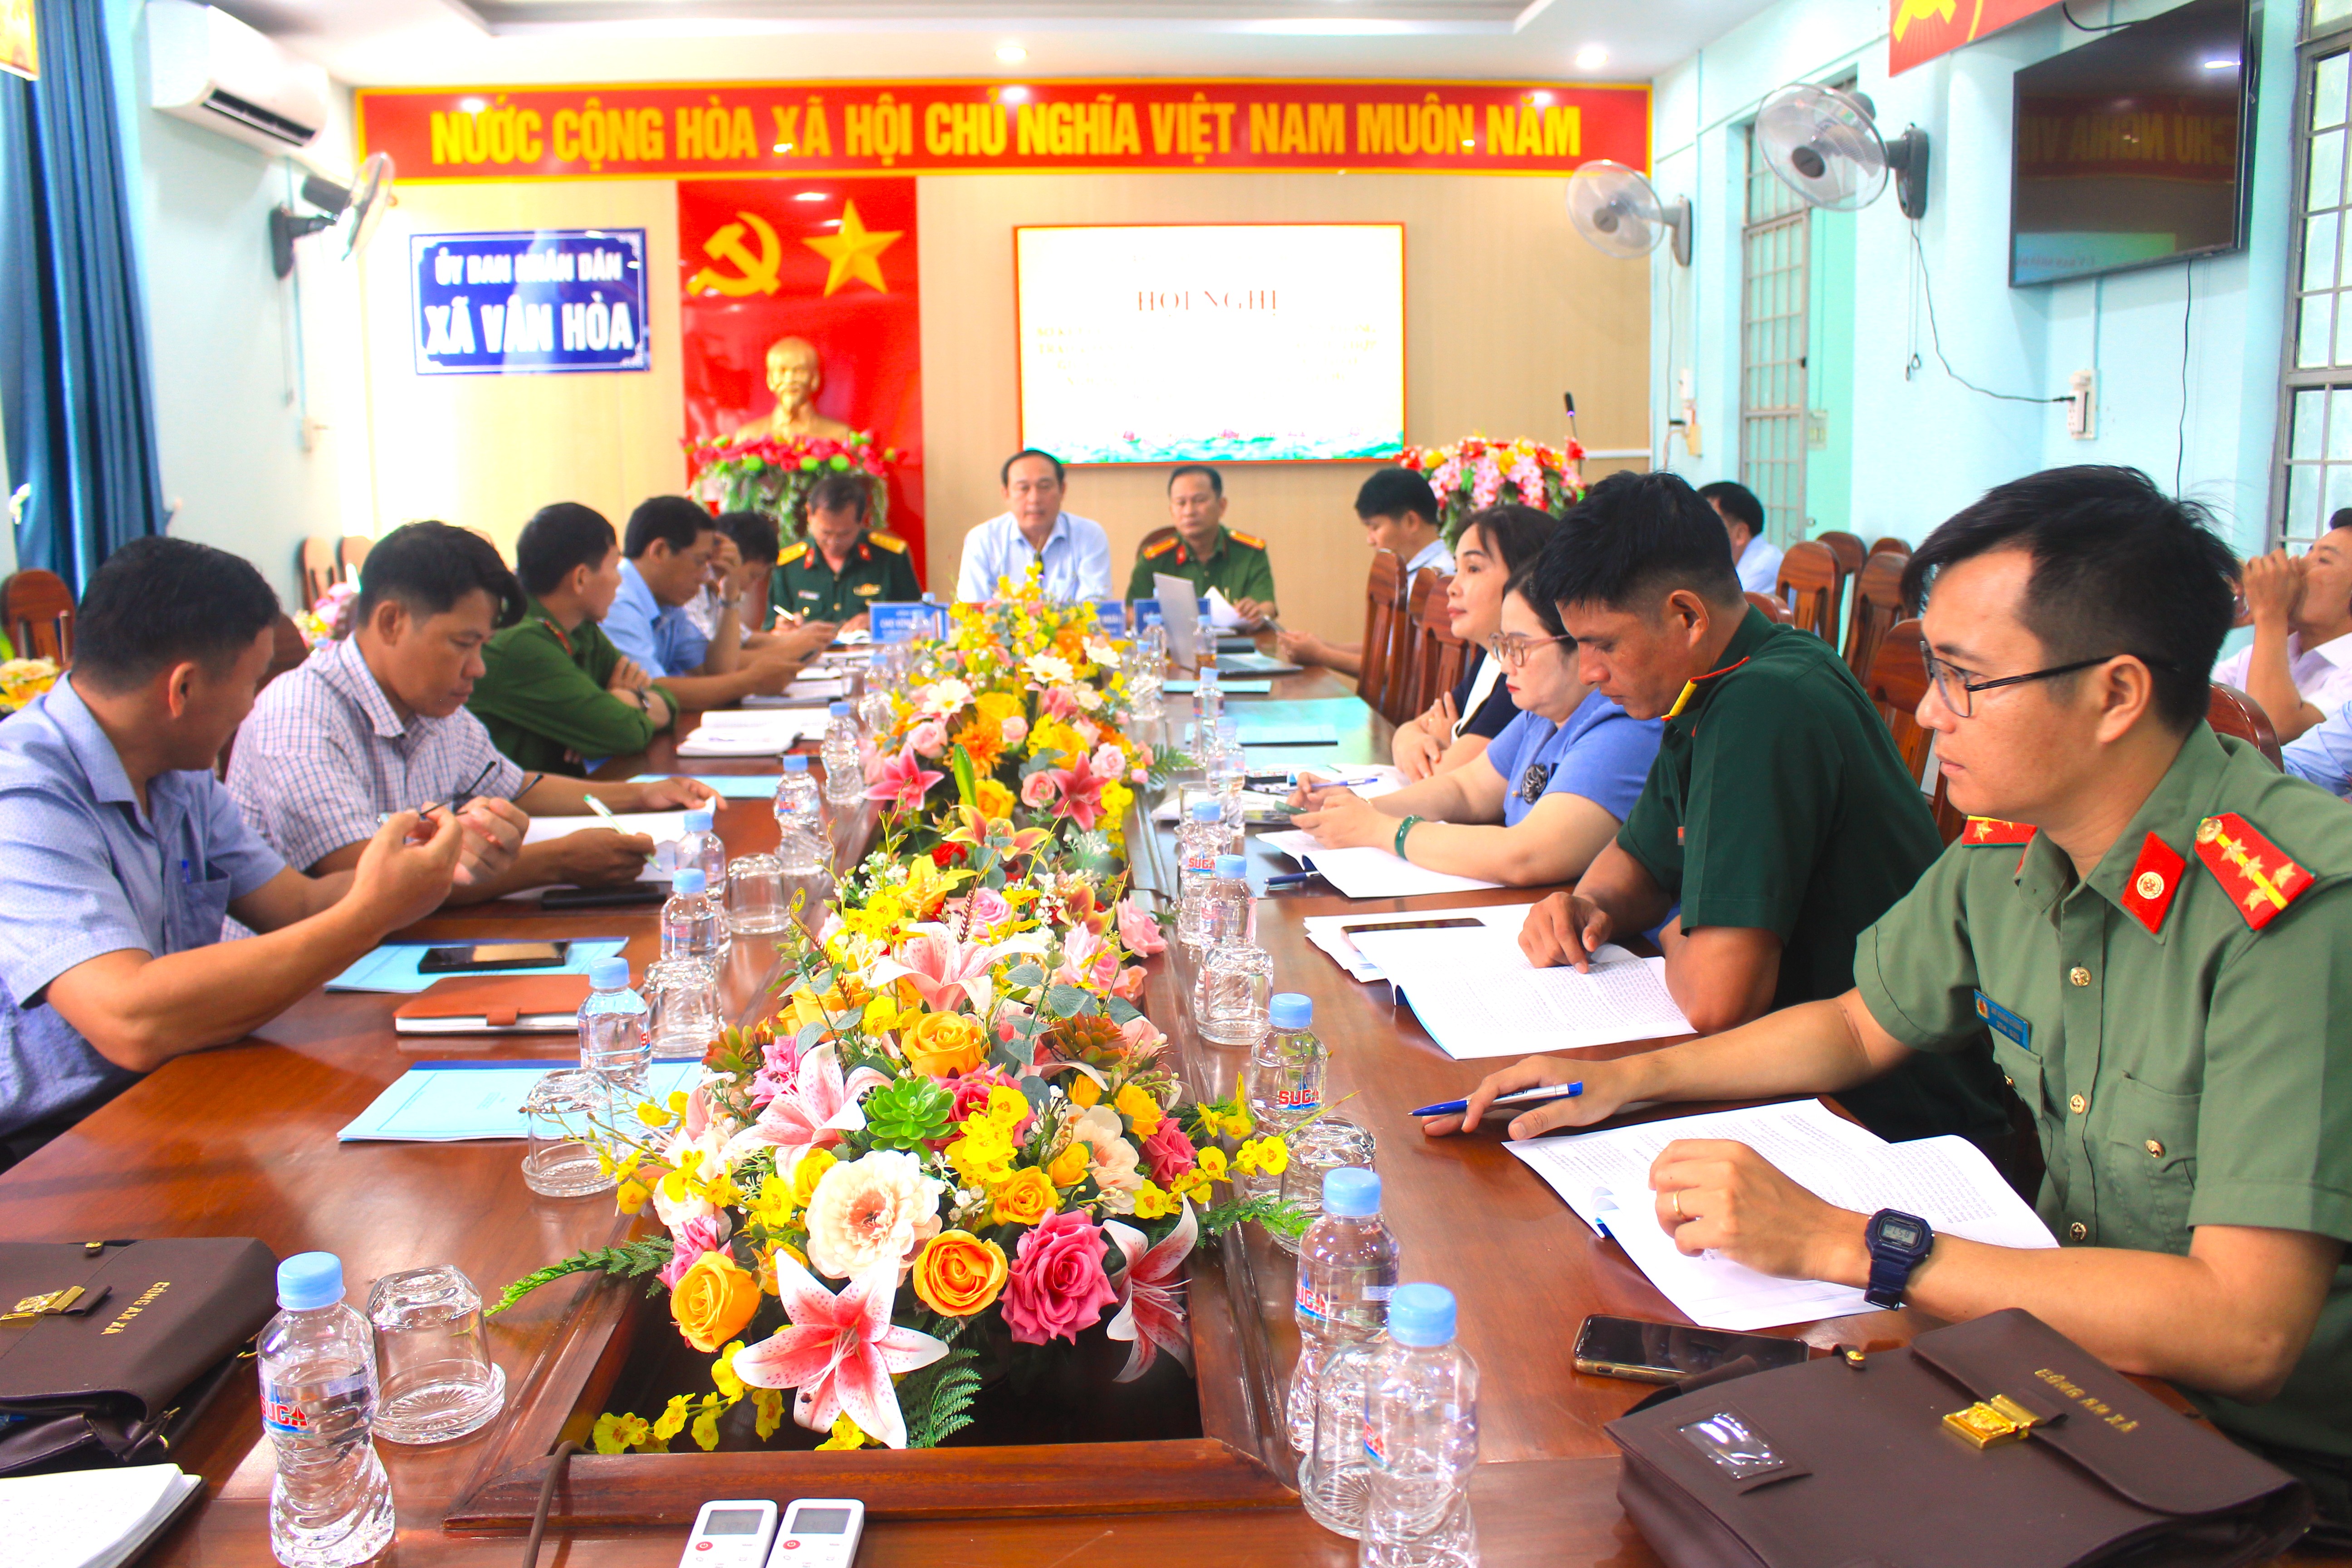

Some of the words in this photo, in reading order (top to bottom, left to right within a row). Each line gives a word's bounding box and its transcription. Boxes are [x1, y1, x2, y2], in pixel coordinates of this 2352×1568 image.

[431, 93, 543, 165] NƯỚC
[553, 97, 665, 171] CỘNG
[676, 95, 758, 161] HÒA
[772, 96, 831, 157] XÃ
[845, 92, 912, 167] HỘI
[925, 87, 1006, 156] CHỦ
[1017, 93, 1142, 156] NGHĨA
[1149, 92, 1235, 163] VIỆT
[1250, 103, 1346, 155] NAM
[1357, 92, 1474, 155] MUÔN
[1486, 95, 1582, 157] NĂM
[466, 254, 512, 284] BAN
[514, 248, 575, 283] NHÂN
[578, 247, 622, 281] DÂN
[425, 295, 476, 355] XÃ
[561, 291, 635, 352] HÒA
